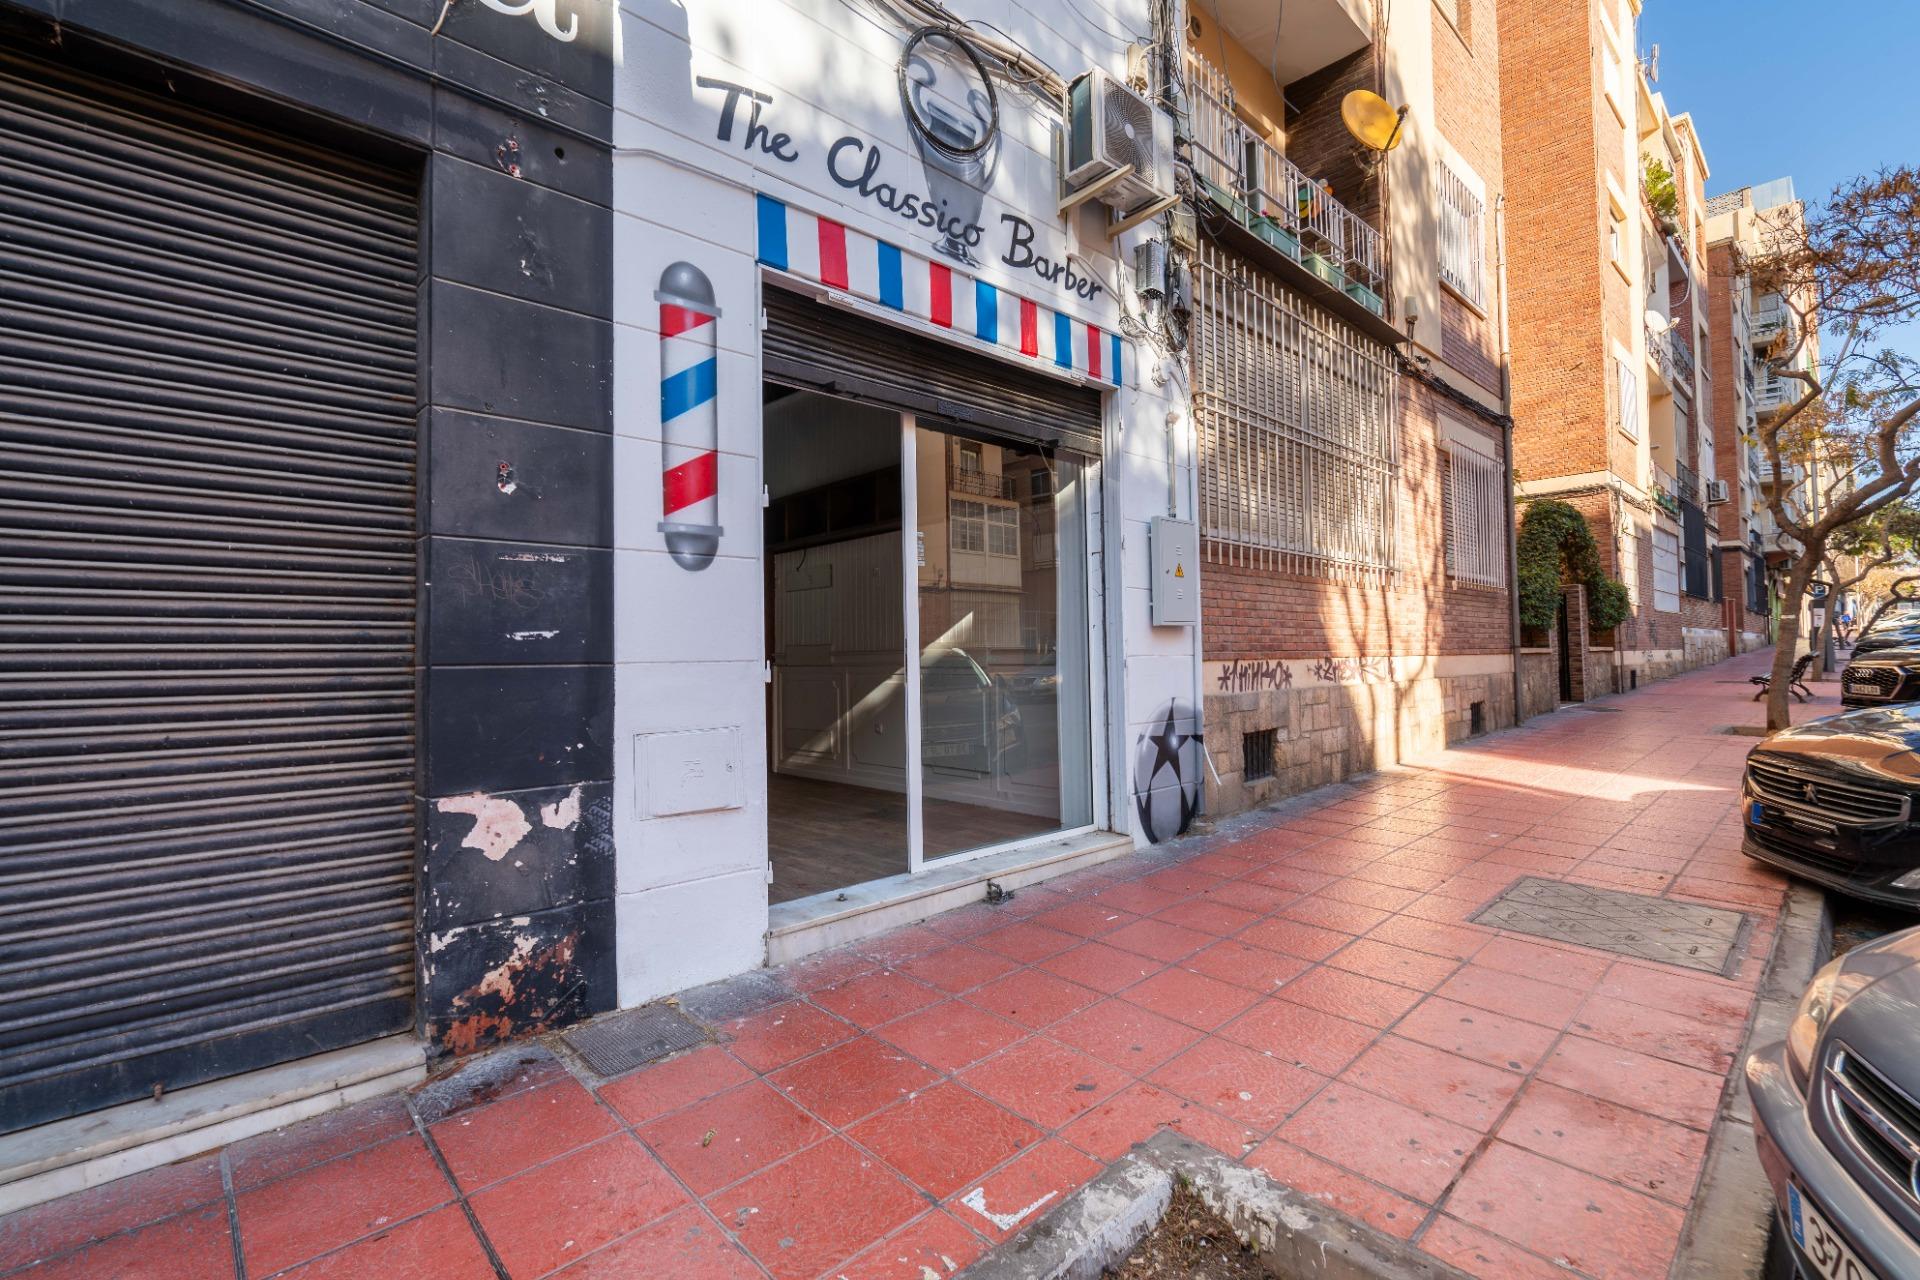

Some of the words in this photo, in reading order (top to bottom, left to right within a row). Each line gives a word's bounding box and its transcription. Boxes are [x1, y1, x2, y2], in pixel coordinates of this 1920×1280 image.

[696, 75, 800, 162] The
[827, 136, 985, 247] Classico
[999, 214, 1102, 301] Barber
